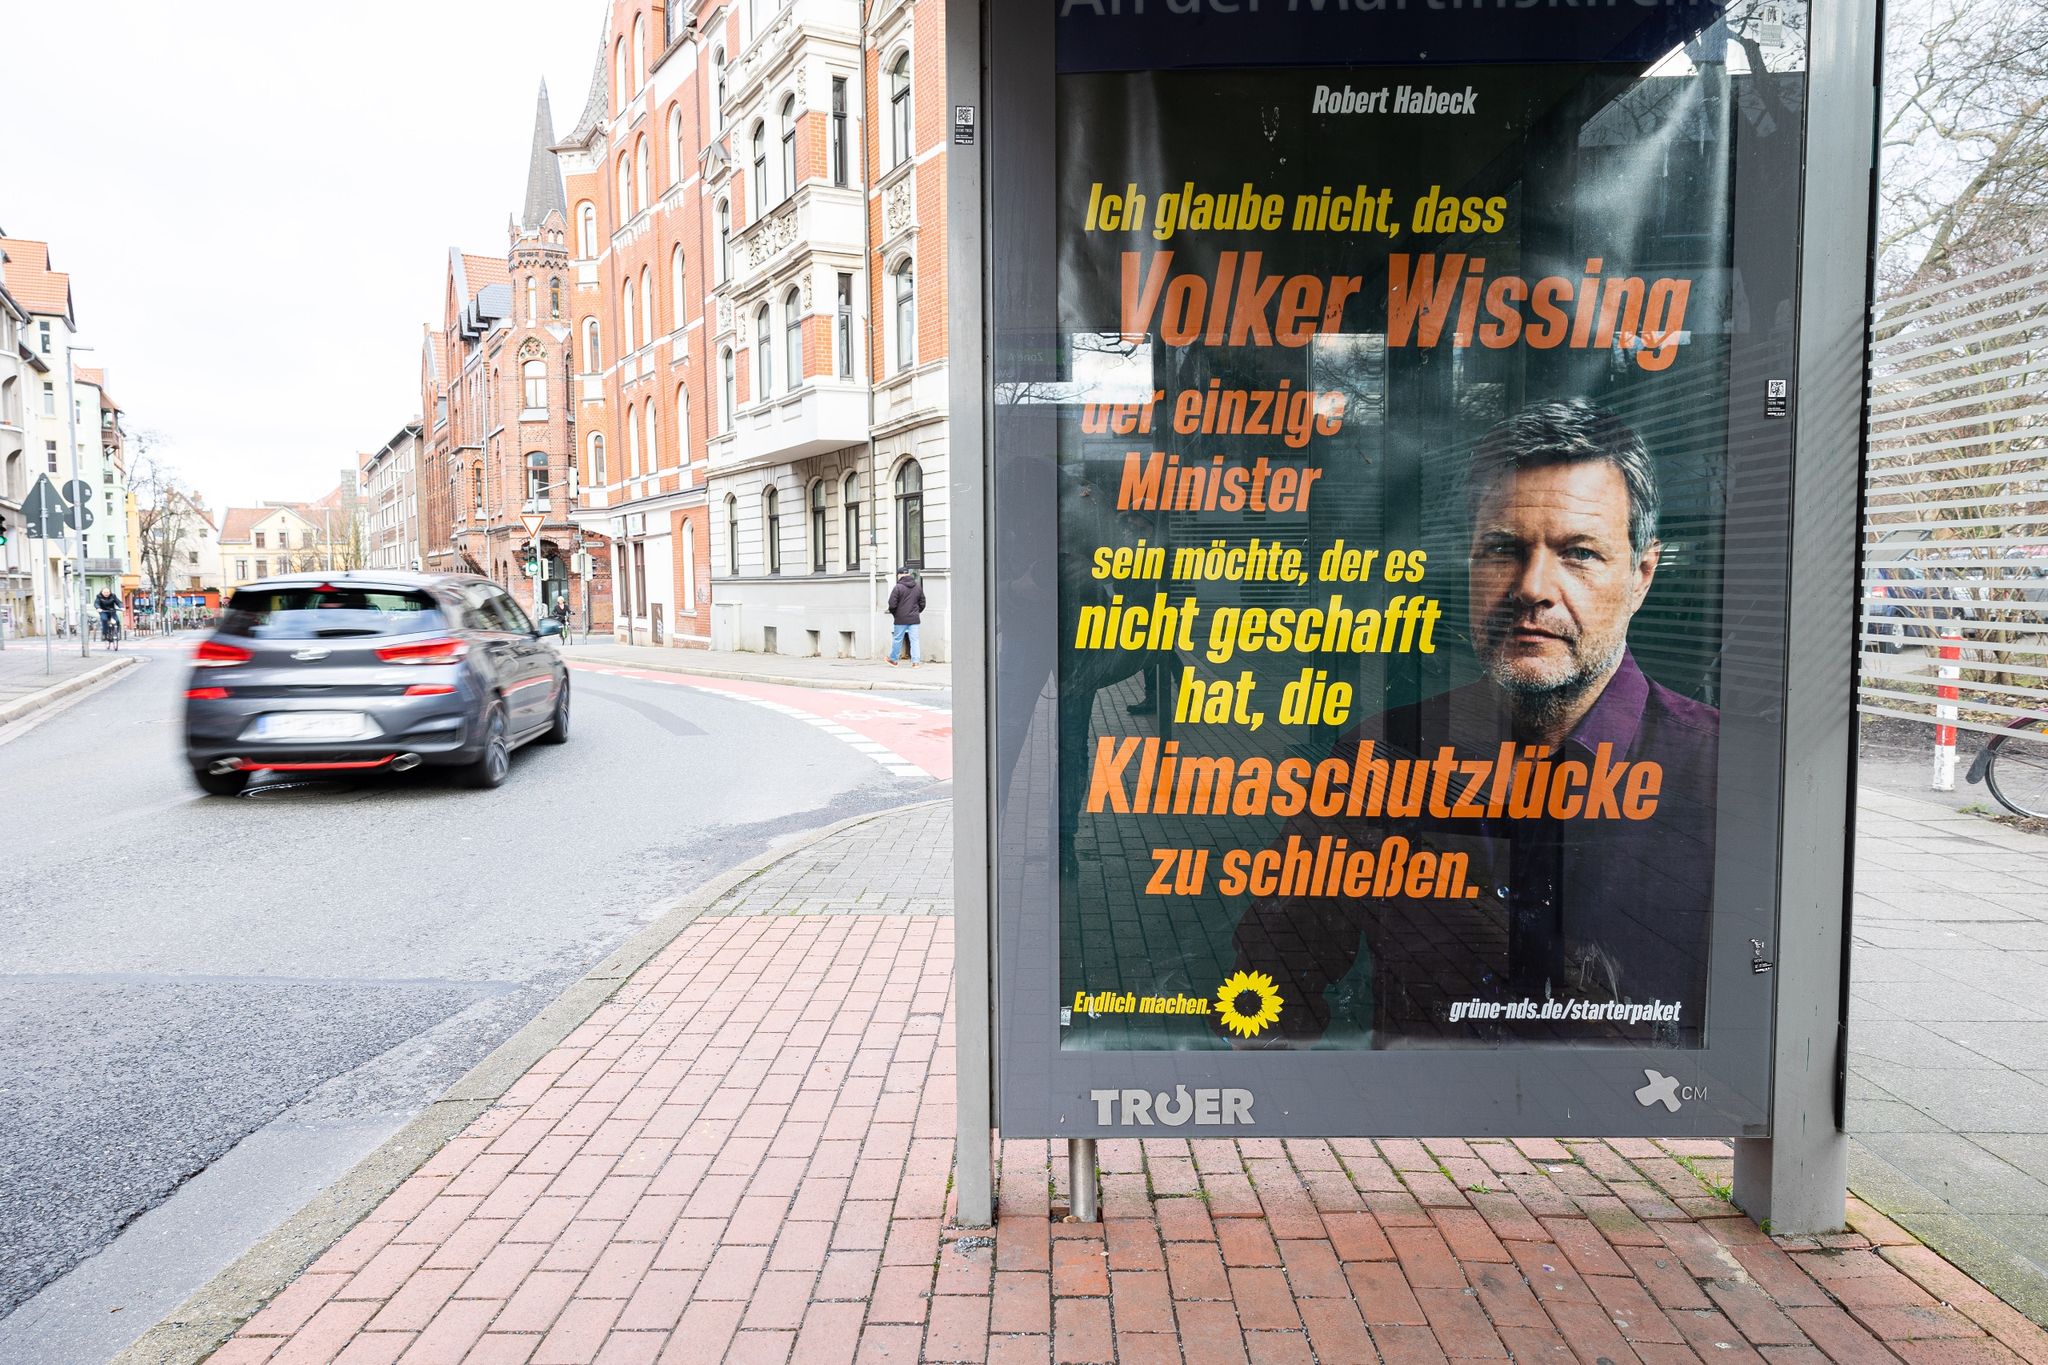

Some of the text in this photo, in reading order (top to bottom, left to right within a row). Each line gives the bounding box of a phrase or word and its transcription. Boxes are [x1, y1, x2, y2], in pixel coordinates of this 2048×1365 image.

[1312, 85, 1478, 116] Robert Habeck
[1086, 181, 1507, 241] Ich glaube nicht, dass
[1118, 249, 1691, 372] Volker Wissing
[1172, 377, 1345, 448] einzige
[1115, 450, 1323, 512] Minister
[1091, 537, 1428, 587] sein möchte, der es
[1074, 592, 1443, 665] nicht geschafft
[1173, 665, 1353, 732] hat, die
[1085, 735, 1664, 821] Klimaschutzlücke
[1144, 835, 1480, 899] zu schließen.
[1072, 990, 1212, 1015] Endlich machen.
[1448, 997, 1683, 1025] grüne-nds.de/starterpaket
[1681, 1085, 1709, 1102] CM
